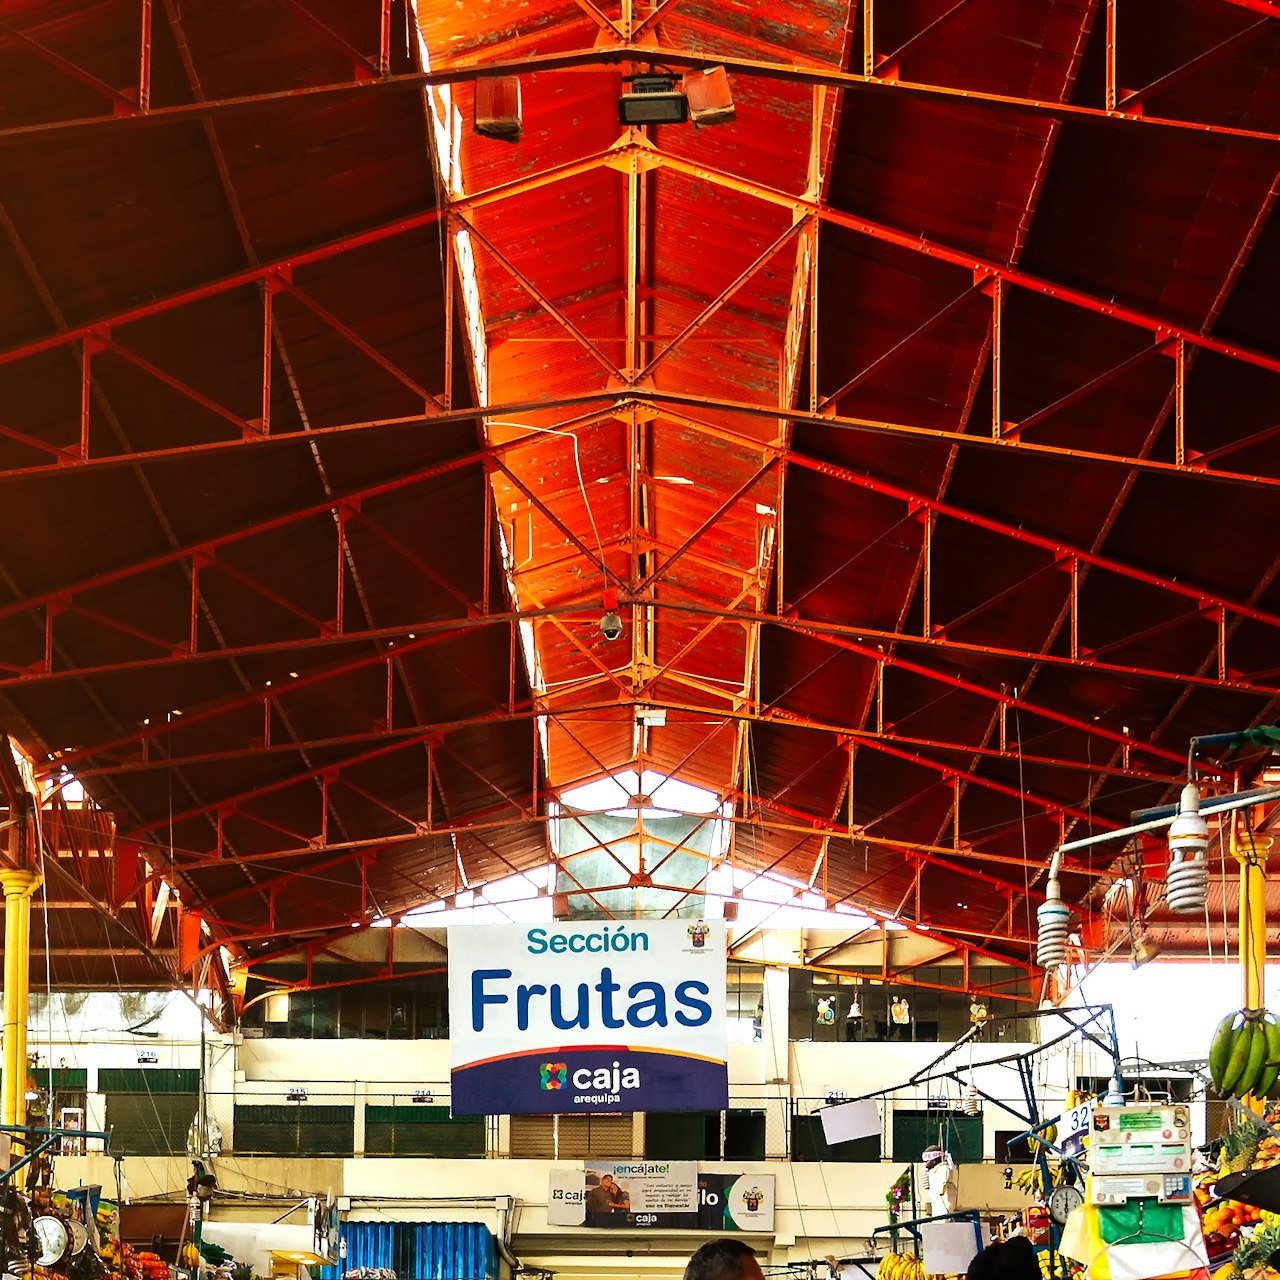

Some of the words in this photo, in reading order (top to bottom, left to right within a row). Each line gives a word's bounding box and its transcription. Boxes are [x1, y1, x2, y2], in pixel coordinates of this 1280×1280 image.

[527, 925, 649, 954] Sección
[471, 966, 713, 1033] Frutas
[572, 1060, 641, 1094] caja
[574, 1093, 621, 1105] arequipa
[1071, 1106, 1089, 1131] 32
[613, 1164, 670, 1176] ¡encájate!
[635, 1213, 658, 1224] caja
